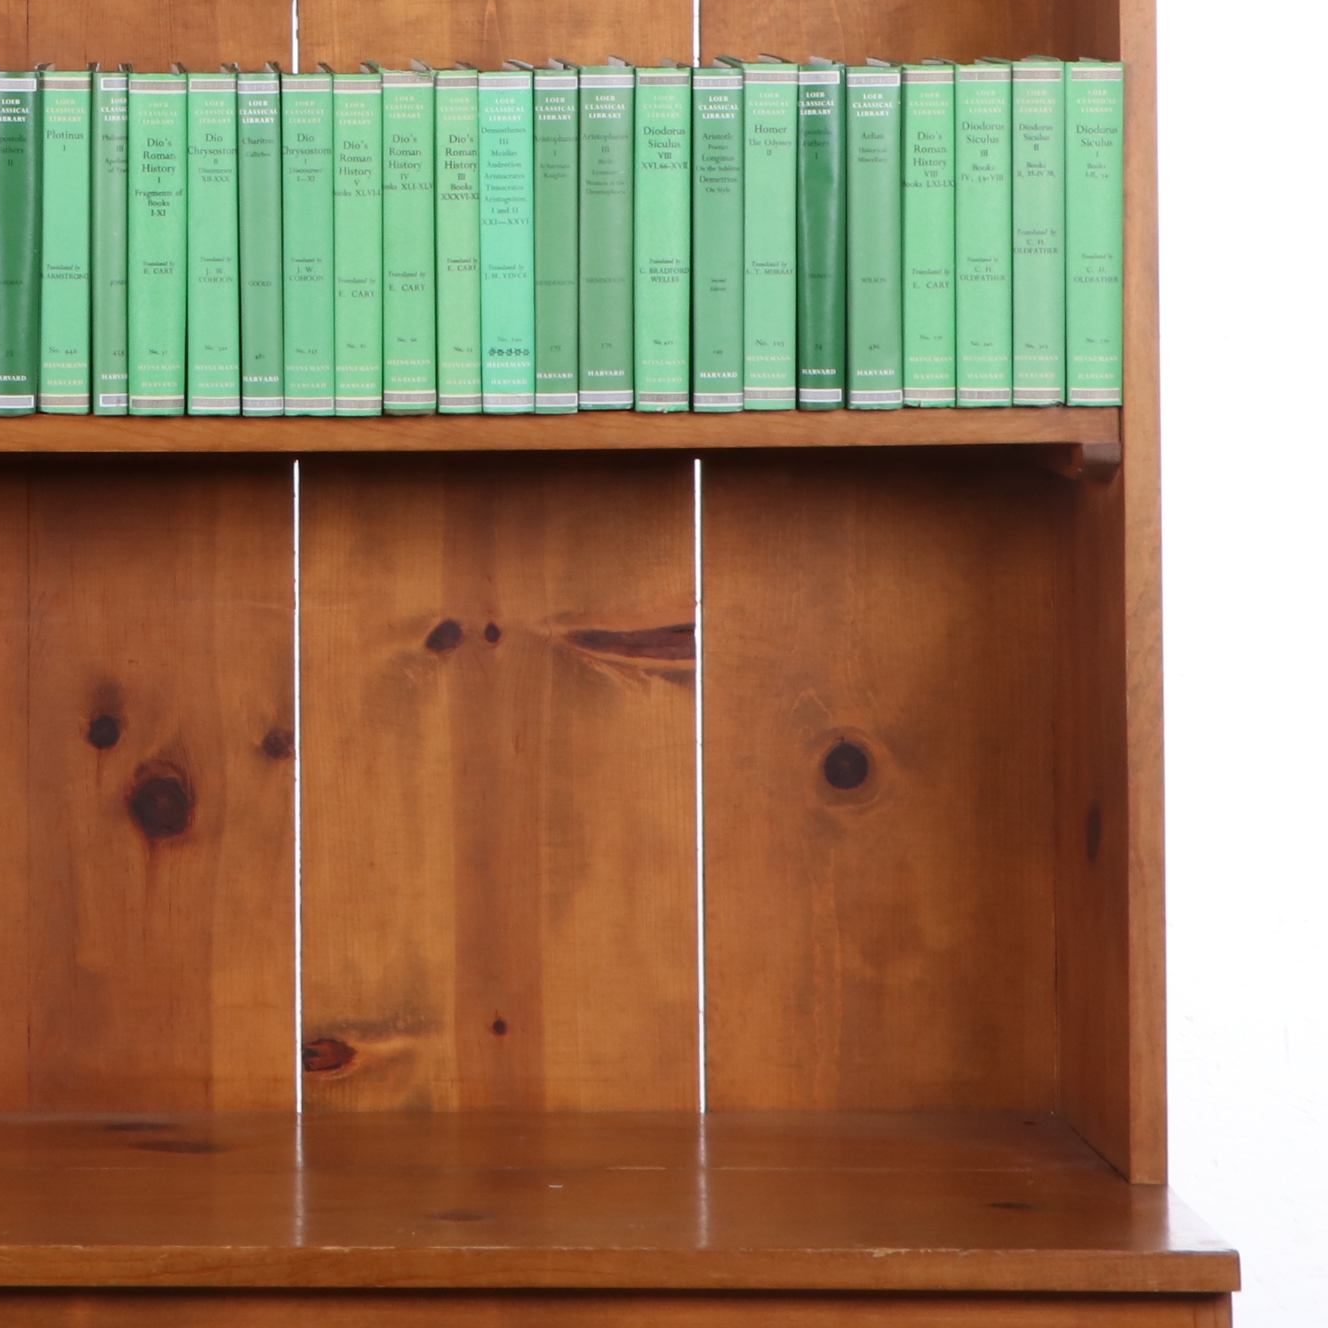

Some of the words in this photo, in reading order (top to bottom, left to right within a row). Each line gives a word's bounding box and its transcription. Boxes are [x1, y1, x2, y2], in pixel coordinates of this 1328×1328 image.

[708, 95, 729, 103] LOEB
[535, 105, 575, 113] CLASSICAL
[698, 104, 739, 112] CLASSICAL
[856, 110, 889, 118] LIBRARY
[242, 117, 274, 125] LIBRARY
[643, 125, 686, 136] Diodorus
[754, 123, 787, 134] Homer
[961, 121, 1005, 132] Diodorus
[1018, 123, 1054, 132] Diodorus
[1076, 125, 1118, 135] Diodorus
[46, 130, 84, 140] Plotinus
[205, 133, 223, 142] Dio
[296, 133, 315, 143] Dio
[392, 134, 417, 144] Dio's
[448, 134, 474, 144] Dio's
[917, 131, 943, 141] Dio's
[966, 134, 1000, 144] Siculus
[147, 137, 172, 147] Dio's
[343, 140, 369, 150] Dio's
[647, 139, 681, 149] Siculus
[748, 138, 762, 146] The
[1080, 137, 1113, 147] Siculus
[389, 147, 422, 157] Roman
[445, 147, 478, 157] Roman
[913, 145, 947, 154] Roman
[142, 151, 175, 160] Roman
[339, 154, 372, 163] Roman
[388, 161, 422, 172] History
[444, 160, 478, 172] History
[913, 157, 946, 170] History
[972, 163, 995, 171] Books
[142, 164, 176, 175] History
[338, 167, 372, 179] History
[450, 183, 473, 191] Books
[134, 189, 173, 199] Fragments
[147, 199, 170, 207] Books
[959, 274, 1006, 282] OLDFATHER
[401, 283, 425, 291] CARY
[351, 290, 375, 298] CARY
[699, 371, 738, 379] HARVARD
